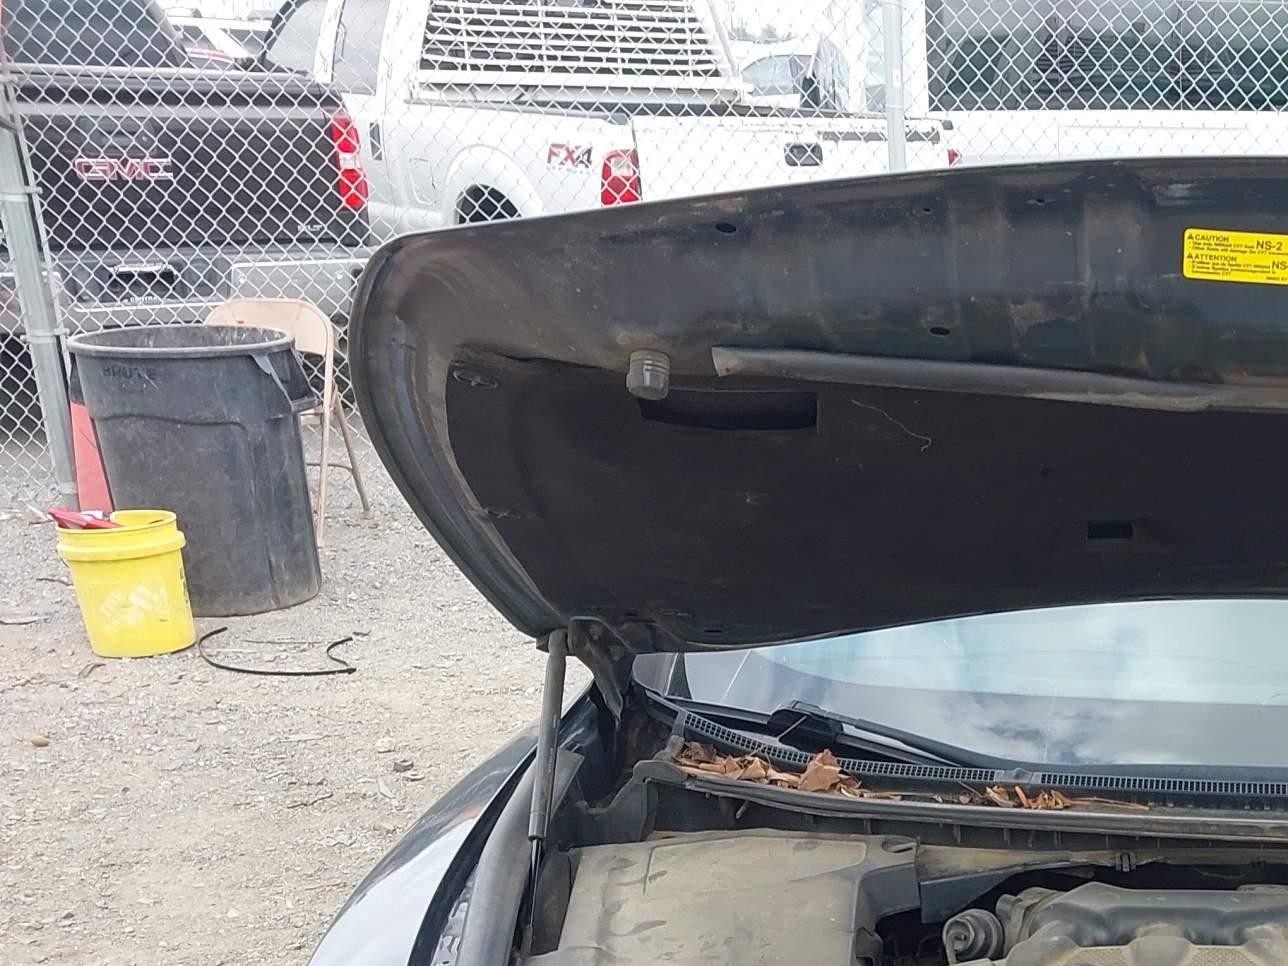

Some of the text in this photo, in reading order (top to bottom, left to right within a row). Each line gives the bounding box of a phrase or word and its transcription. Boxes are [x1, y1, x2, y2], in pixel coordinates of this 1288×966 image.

[547, 143, 592, 168] FX4
[75, 159, 173, 180] GMC
[1194, 233, 1230, 242] CAUTION
[1256, 240, 1283, 251] NS-2
[1194, 254, 1238, 263] ATTENTION
